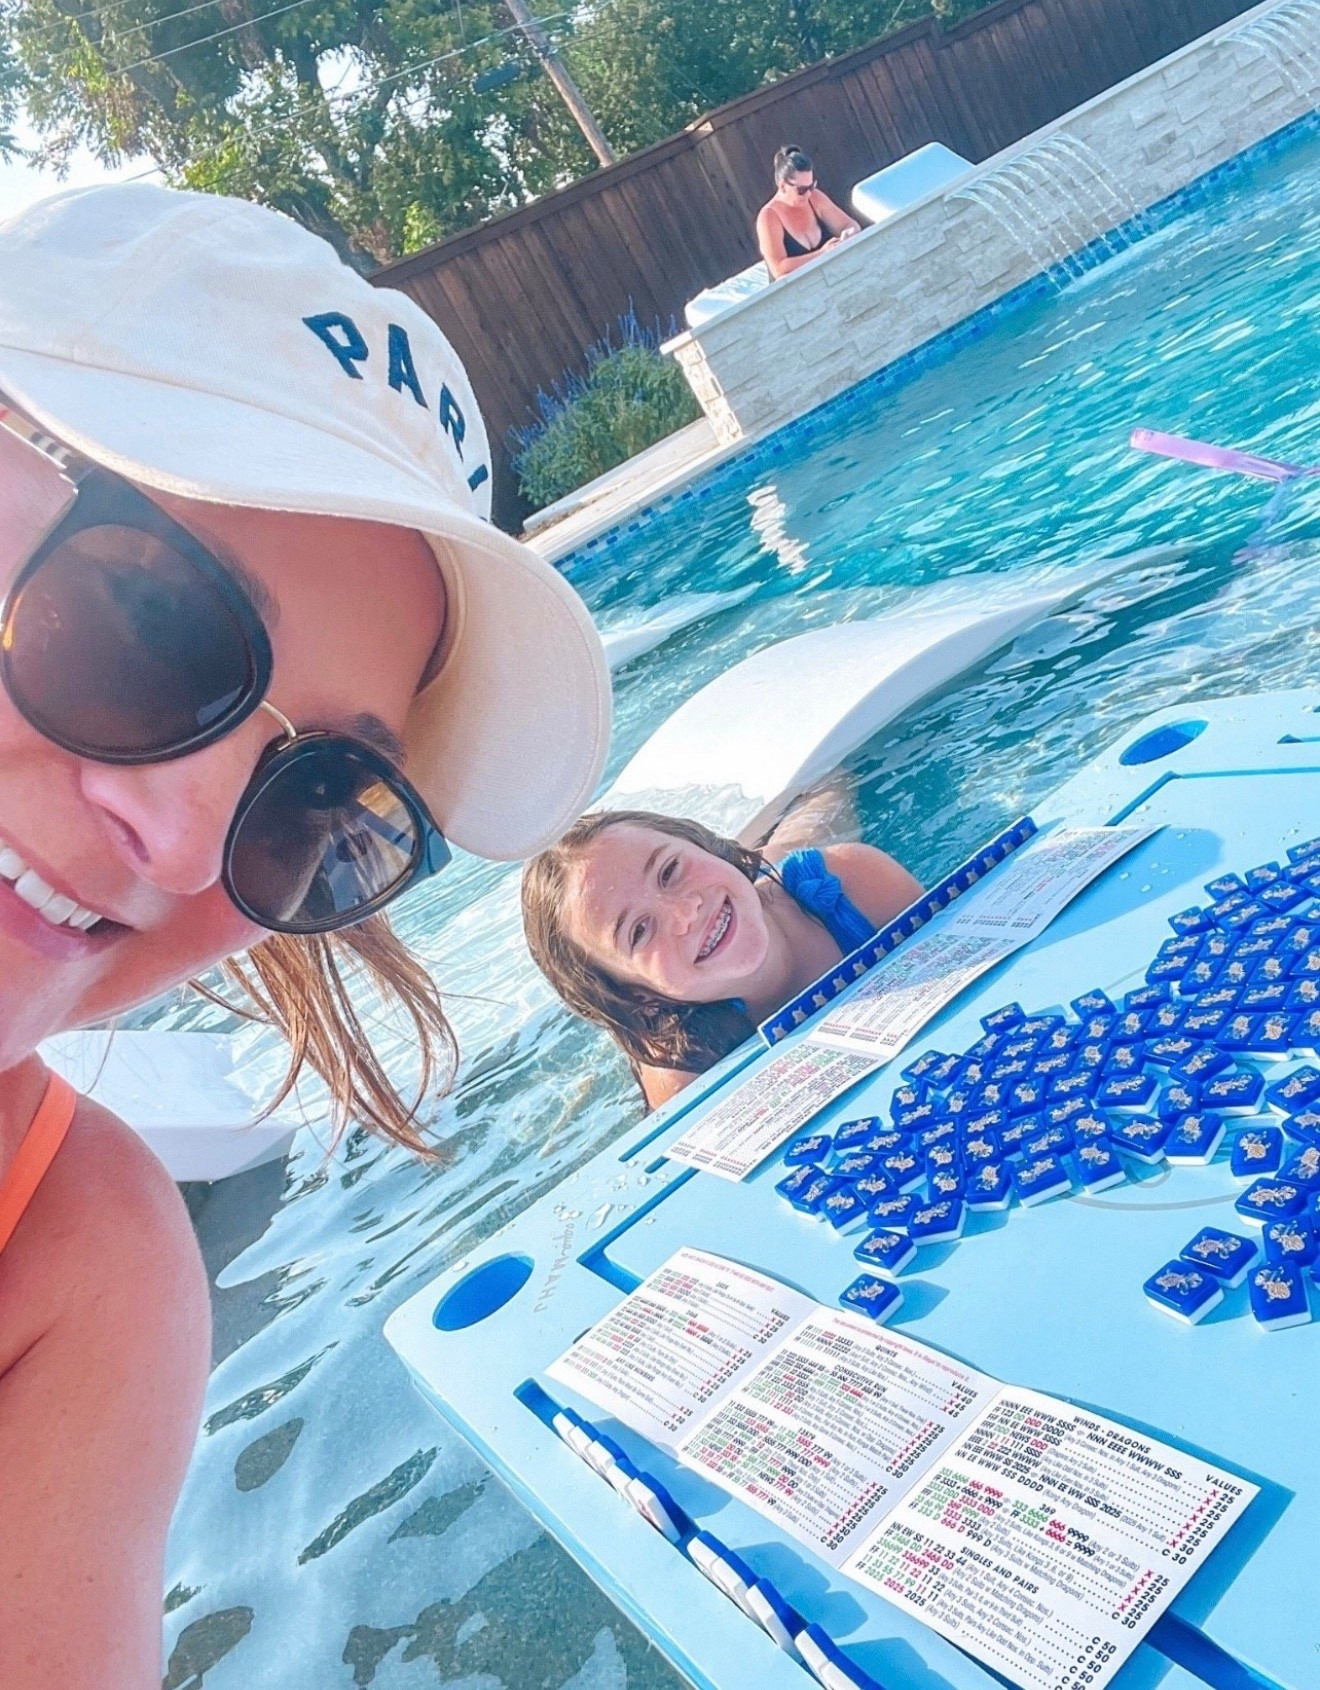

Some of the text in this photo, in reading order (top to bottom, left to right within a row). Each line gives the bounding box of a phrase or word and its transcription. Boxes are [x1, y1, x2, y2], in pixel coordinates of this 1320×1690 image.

[302, 312, 490, 518] PARI
[952, 1381, 978, 1398] VALUES
[1020, 1406, 1033, 1415] EEE
[1034, 1411, 1057, 1423] WWW
[1056, 1420, 1076, 1431] SSSS
[1087, 1433, 1108, 1445] NNN
[1107, 1442, 1128, 1454] EEEE
[1128, 1450, 1164, 1470] WWWW
[1164, 1467, 1182, 1479] SSS
[1220, 1493, 1234, 1504] 25
[1025, 1418, 1041, 1427] DDD
[1042, 1424, 1064, 1436] DDDD
[1213, 1502, 1228, 1512] 25
[1042, 1434, 1062, 1446] SSSS
[1206, 1510, 1221, 1520] 25
[1074, 1417, 1151, 1453] WINDS DRAGONS
[1017, 1476, 1043, 1491] DDDD
[1172, 1553, 1187, 1564] 30
[1030, 1439, 1048, 1450] DDD
[1200, 1519, 1214, 1529] 25
[1039, 1504, 1056, 1515] 369
[1039, 1474, 1058, 1487] NNN
[1058, 1483, 1068, 1492] EE
[1068, 1487, 1085, 1499] WW
[1100, 1504, 1121, 1518] 2025
[1179, 1544, 1194, 1555] 30
[1206, 1475, 1242, 1495] VALUES
[961, 1547, 1039, 1594] SINGLES AND PAIRS
[962, 1517, 981, 1531] 3333
[1128, 1608, 1143, 1620] 25
[977, 1504, 995, 1516] DDD
[1141, 1591, 1156, 1603] 25
[1010, 1510, 1021, 1518] FF
[1046, 1529, 1065, 1542] 6666
[1074, 1542, 1095, 1557] 9999
[1148, 1583, 1163, 1594] 25
[1049, 1520, 1065, 1531] 666
[1067, 1528, 1089, 1542] 9999
[1154, 1575, 1169, 1586] 25
[1186, 1535, 1201, 1546] 25
[1193, 1527, 1208, 1538] 25
[884, 1578, 926, 1606] 2025 2025
[902, 1551, 929, 1568] 336699
[928, 1565, 940, 1575] 33
[1087, 1661, 1101, 1673] 50
[922, 1549, 941, 1563] 2468
[941, 1559, 954, 1570] DD
[1095, 1650, 1109, 1663] 50
[924, 1538, 934, 1547] 11
[933, 1544, 945, 1554] 22
[944, 1550, 956, 1560] 33
[956, 1557, 967, 1566] 44
[1102, 1642, 1116, 1654] 50
[928, 1591, 939, 1601] 11
[966, 1530, 983, 1542] 999
[1121, 1617, 1136, 1629] 30
[1134, 1600, 1149, 1611] 25
[922, 1574, 933, 1585] 11
[933, 1581, 945, 1592] 22
[1079, 1671, 1093, 1683] 50
